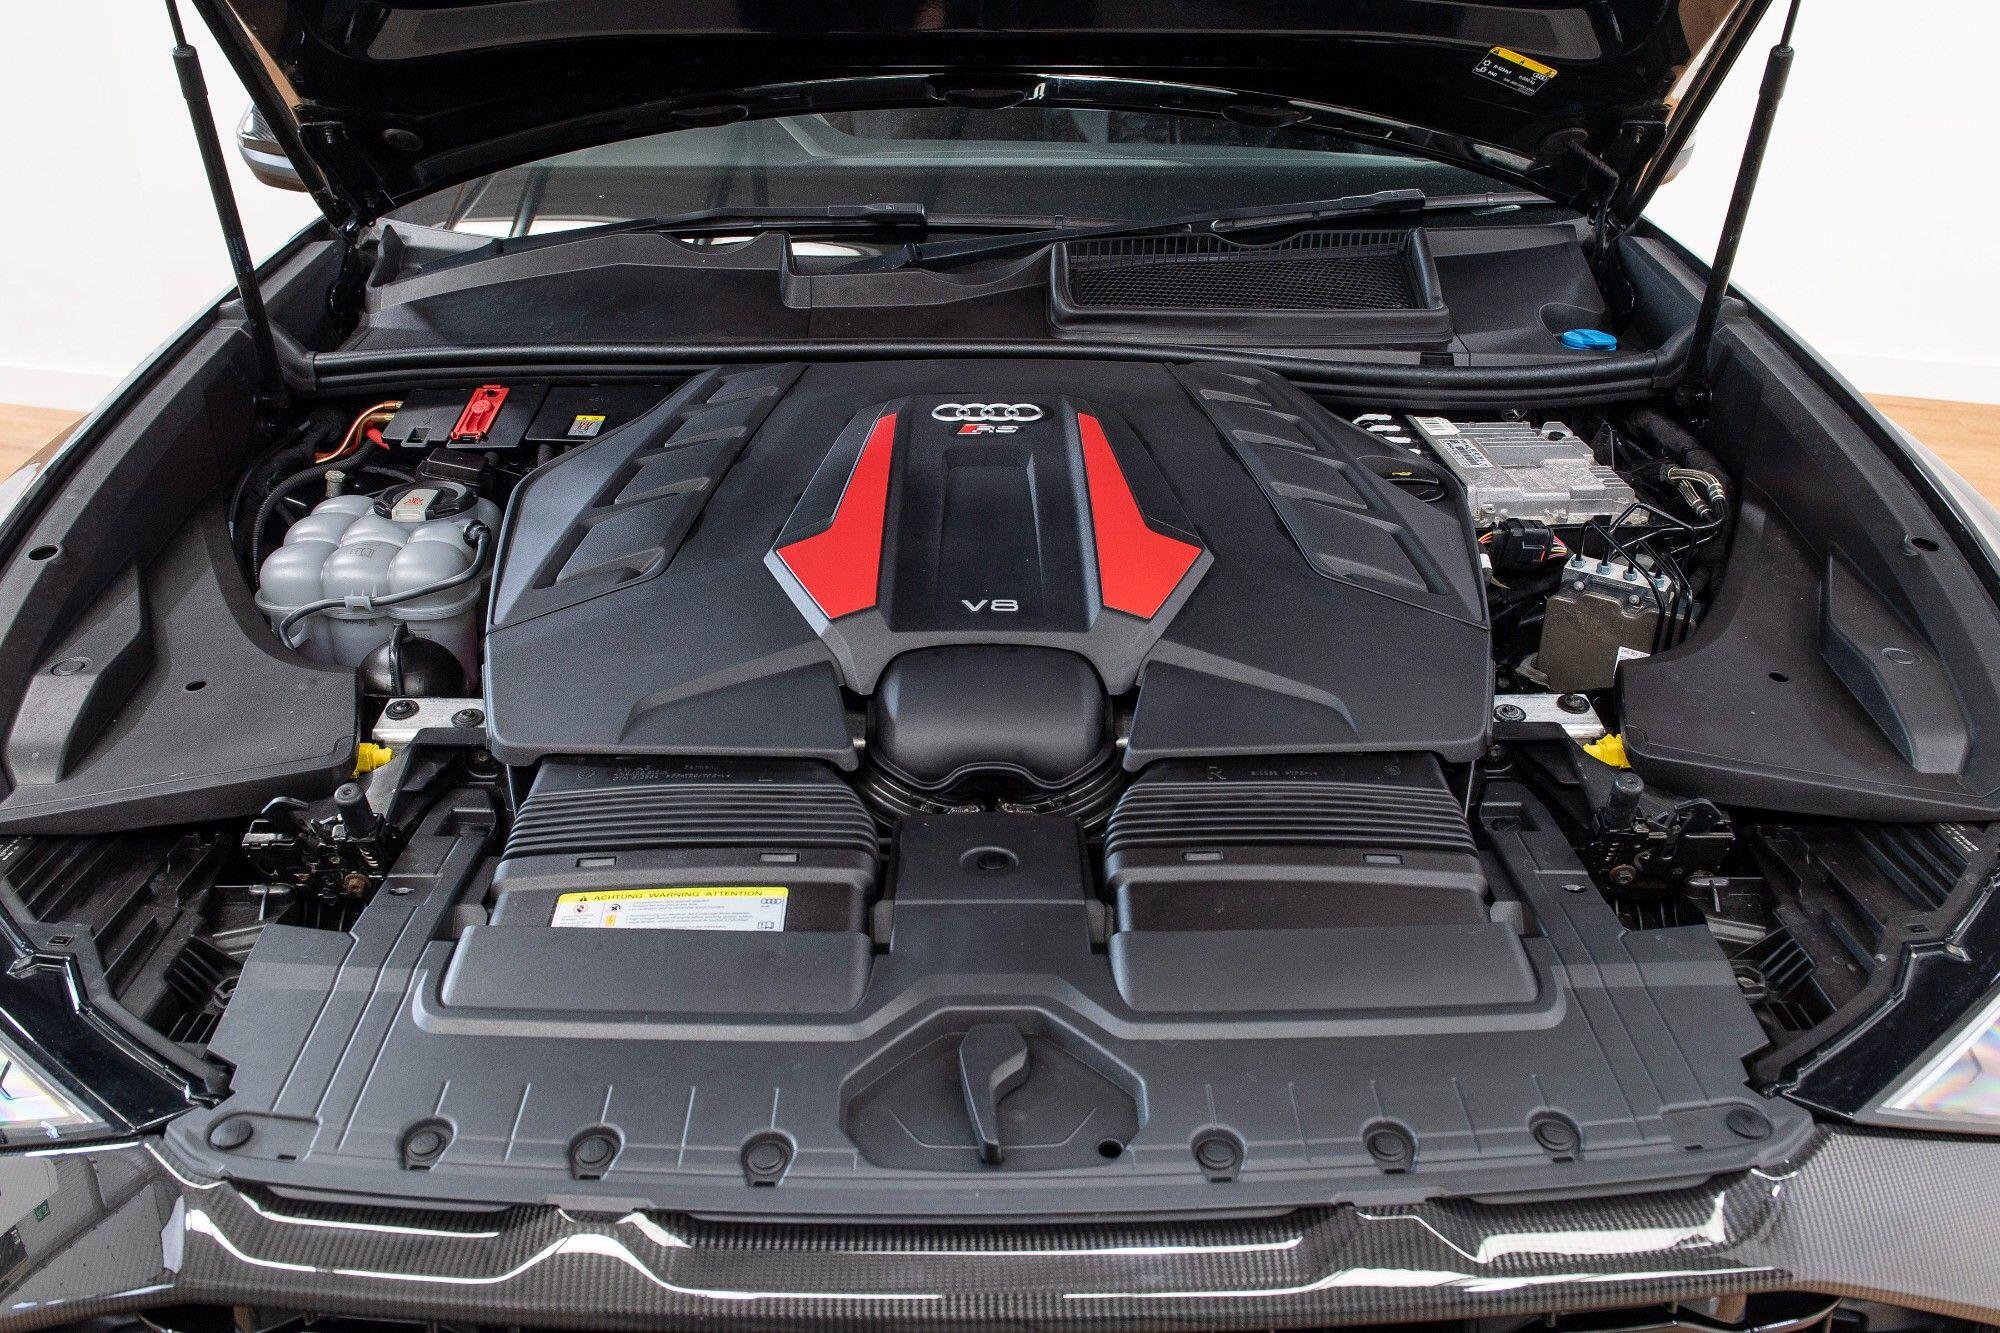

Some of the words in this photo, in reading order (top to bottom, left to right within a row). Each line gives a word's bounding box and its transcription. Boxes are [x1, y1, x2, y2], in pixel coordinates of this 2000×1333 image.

[958, 424, 1019, 434] RS
[961, 599, 1019, 612] V8
[593, 893, 643, 901] ACHTUNG
